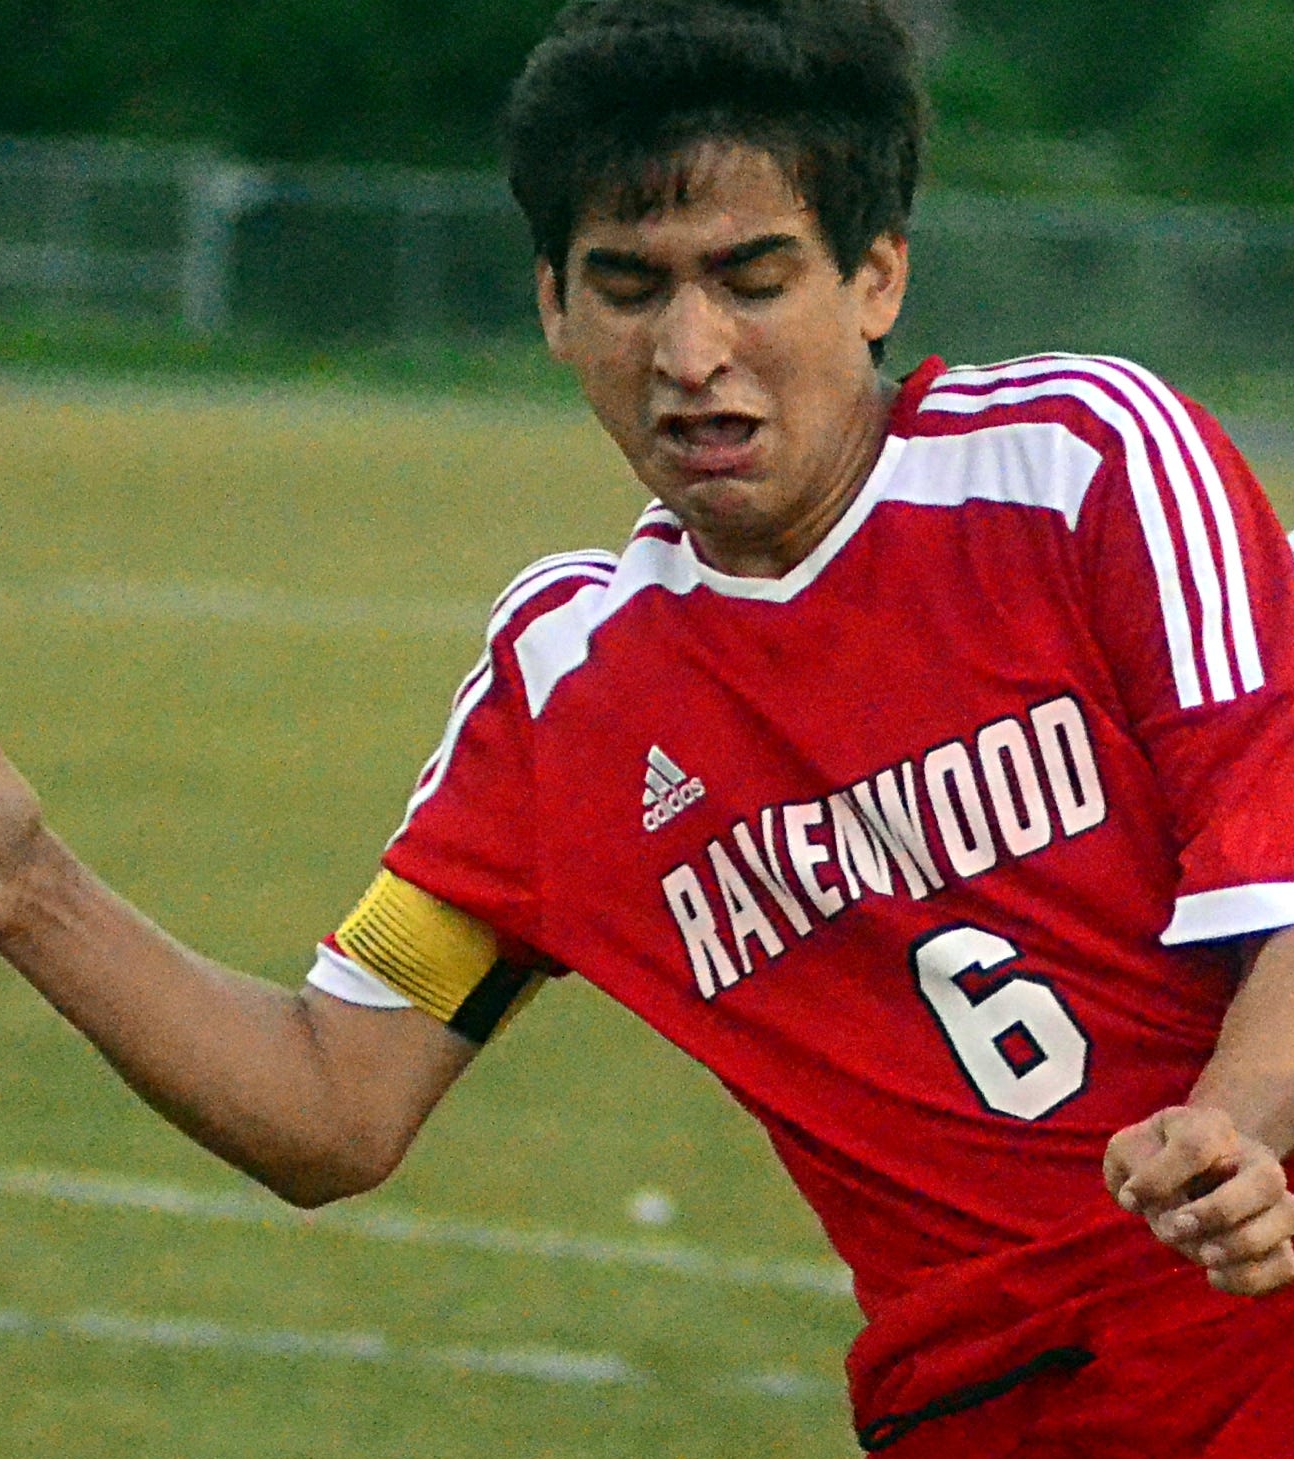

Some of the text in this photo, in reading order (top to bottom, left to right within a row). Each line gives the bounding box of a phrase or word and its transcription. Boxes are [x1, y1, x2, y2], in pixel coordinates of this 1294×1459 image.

[642, 777, 705, 832] adidas
[661, 695, 1106, 1001] RAVENWOOD
[910, 920, 1090, 1122] 6
